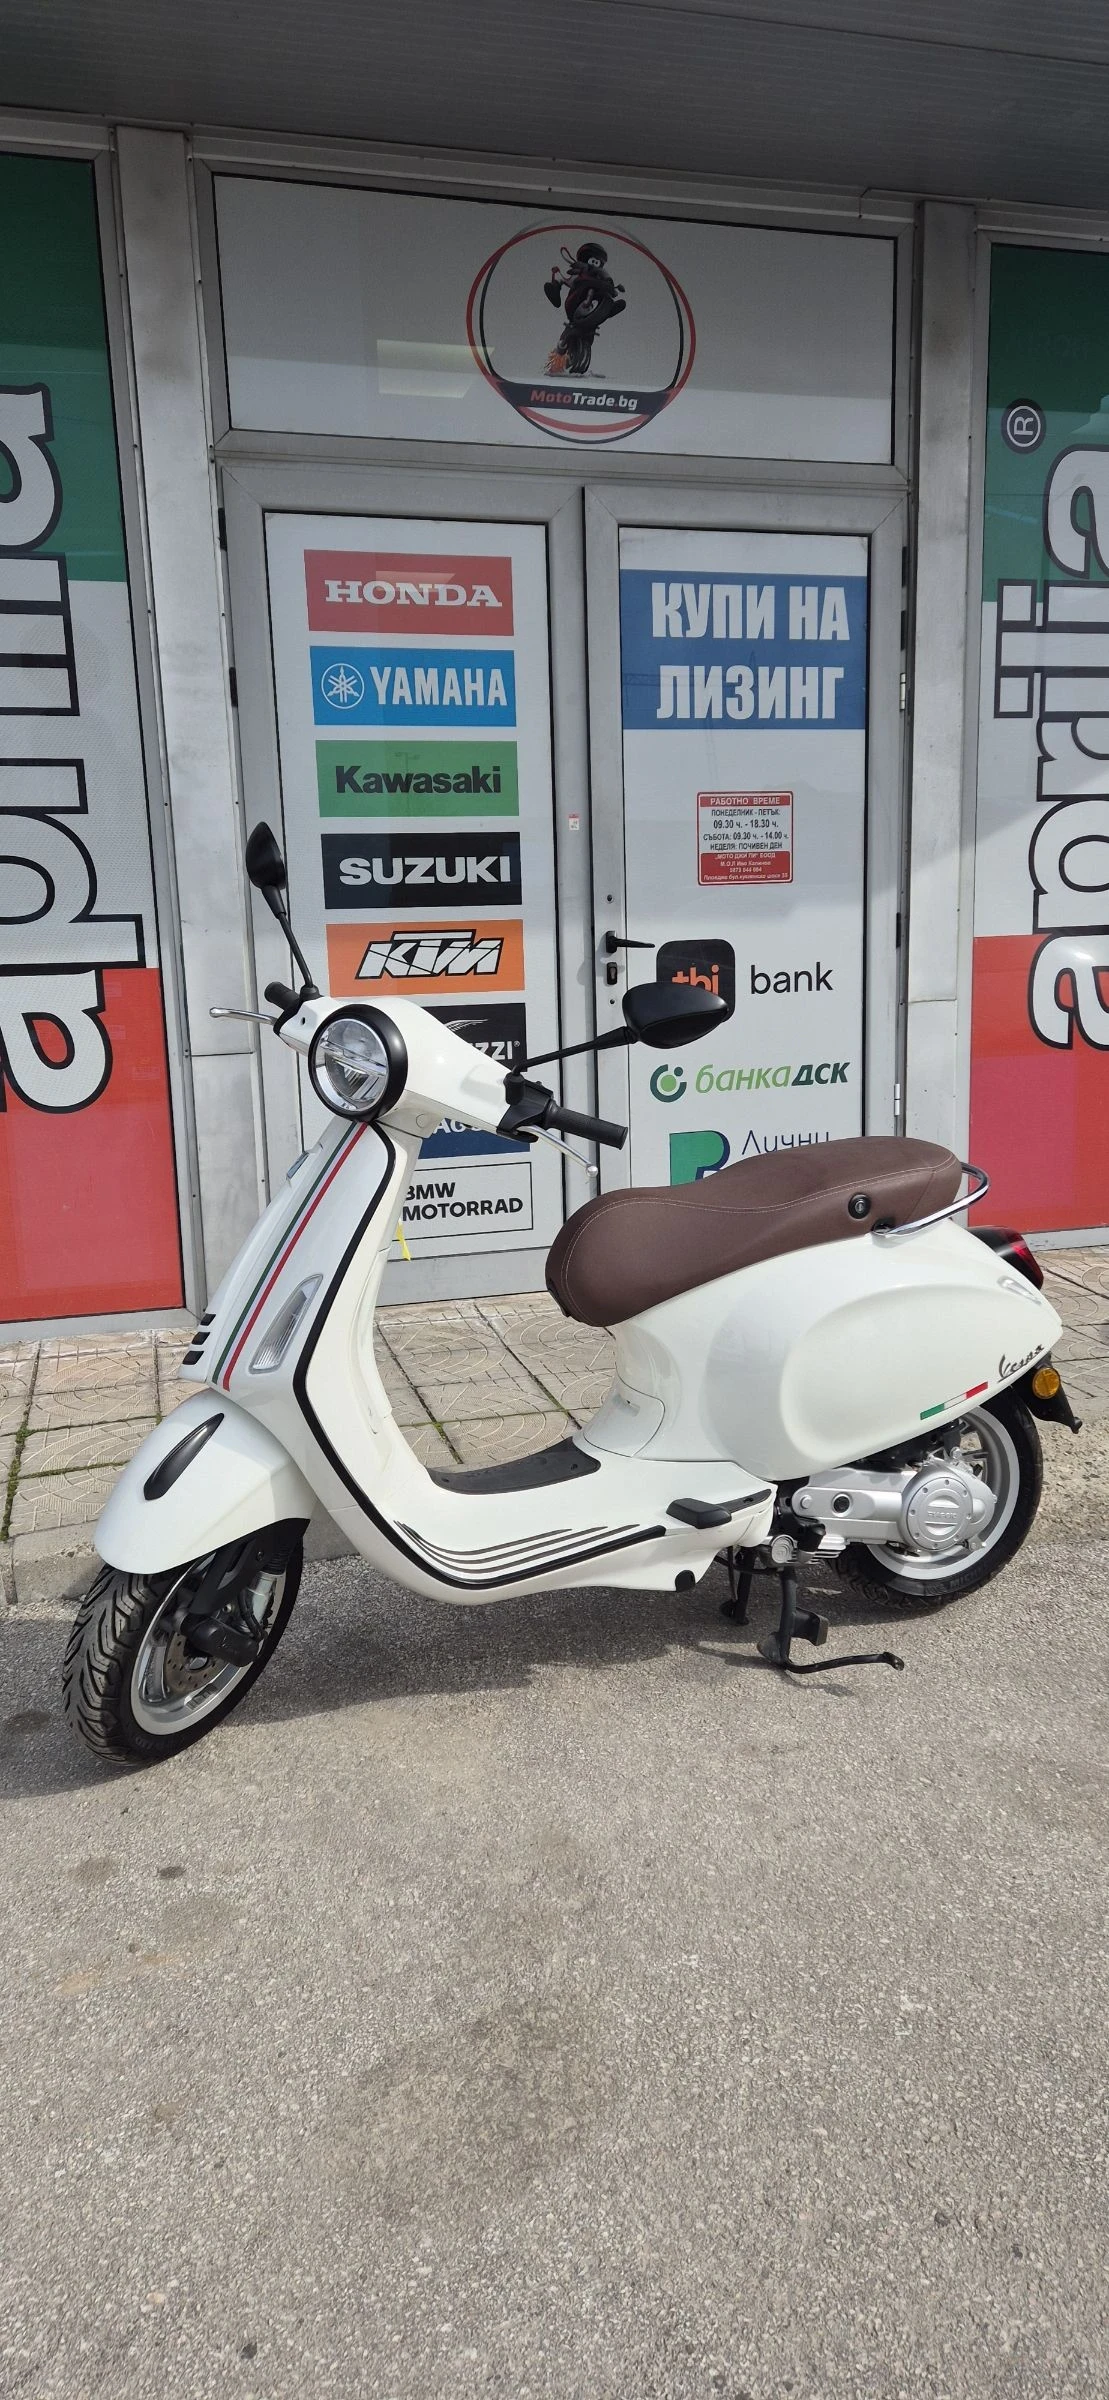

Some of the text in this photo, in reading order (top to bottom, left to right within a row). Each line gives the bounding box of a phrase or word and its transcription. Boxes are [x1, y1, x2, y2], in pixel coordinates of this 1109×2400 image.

[530, 389, 638, 411] MotoTrade.bg
[324, 579, 502, 607] HONDA
[651, 582, 850, 641] КУПИ НА
[370, 666, 507, 706] YAMAHA
[656, 665, 845, 720] ЛИЗИНГ
[335, 765, 502, 794] Kawasaki
[710, 796, 781, 805] РАБОТНО ВРЕМЕ
[711, 808, 753, 817] ПОНЕДЕЛНИК
[758, 808, 780, 816] ПЕТЪК:
[703, 833, 731, 841] СЪБОТА:
[733, 832, 751, 840] 09.30
[765, 831, 782, 840] 14.00
[713, 820, 734, 829] 09.30
[750, 819, 770, 828] 18.30
[710, 842, 782, 851] НЕДЕЛЯ: ПОЧИВЕН ДЕН
[339, 856, 511, 886] SUZUKI
[354, 928, 505, 980] KTM
[750, 961, 834, 995] bank
[741, 1129, 830, 1155] Лични
[406, 1182, 456, 1200] BMW
[402, 1197, 524, 1221] MOTORRAD
